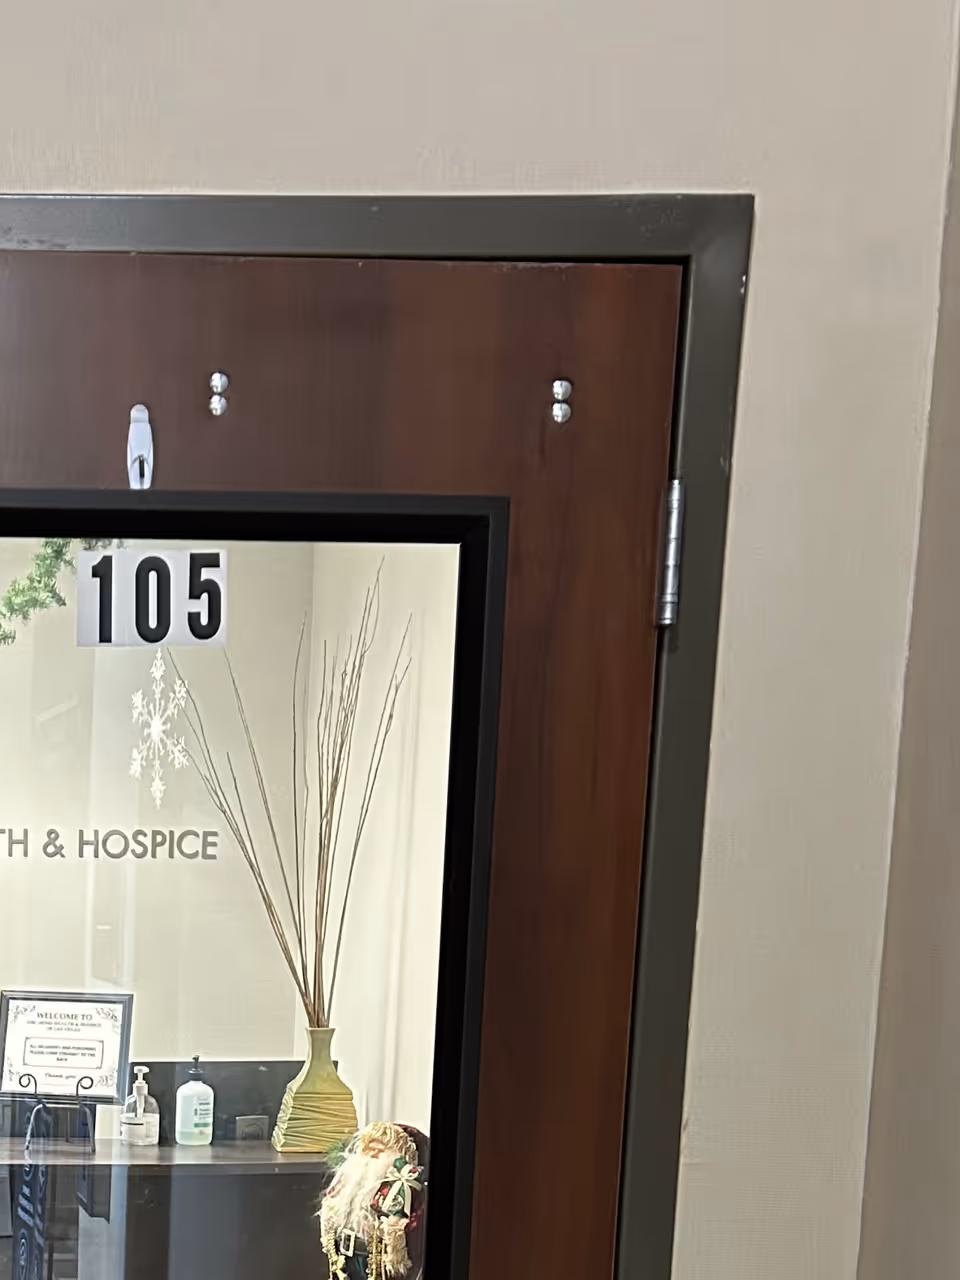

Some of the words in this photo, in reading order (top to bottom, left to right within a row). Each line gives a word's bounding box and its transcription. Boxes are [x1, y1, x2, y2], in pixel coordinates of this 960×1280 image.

[91, 552, 222, 644] 105
[42, 828, 66, 859] &
[78, 829, 219, 860] HOSPICE
[36, 1012, 79, 1020] WELCOME
